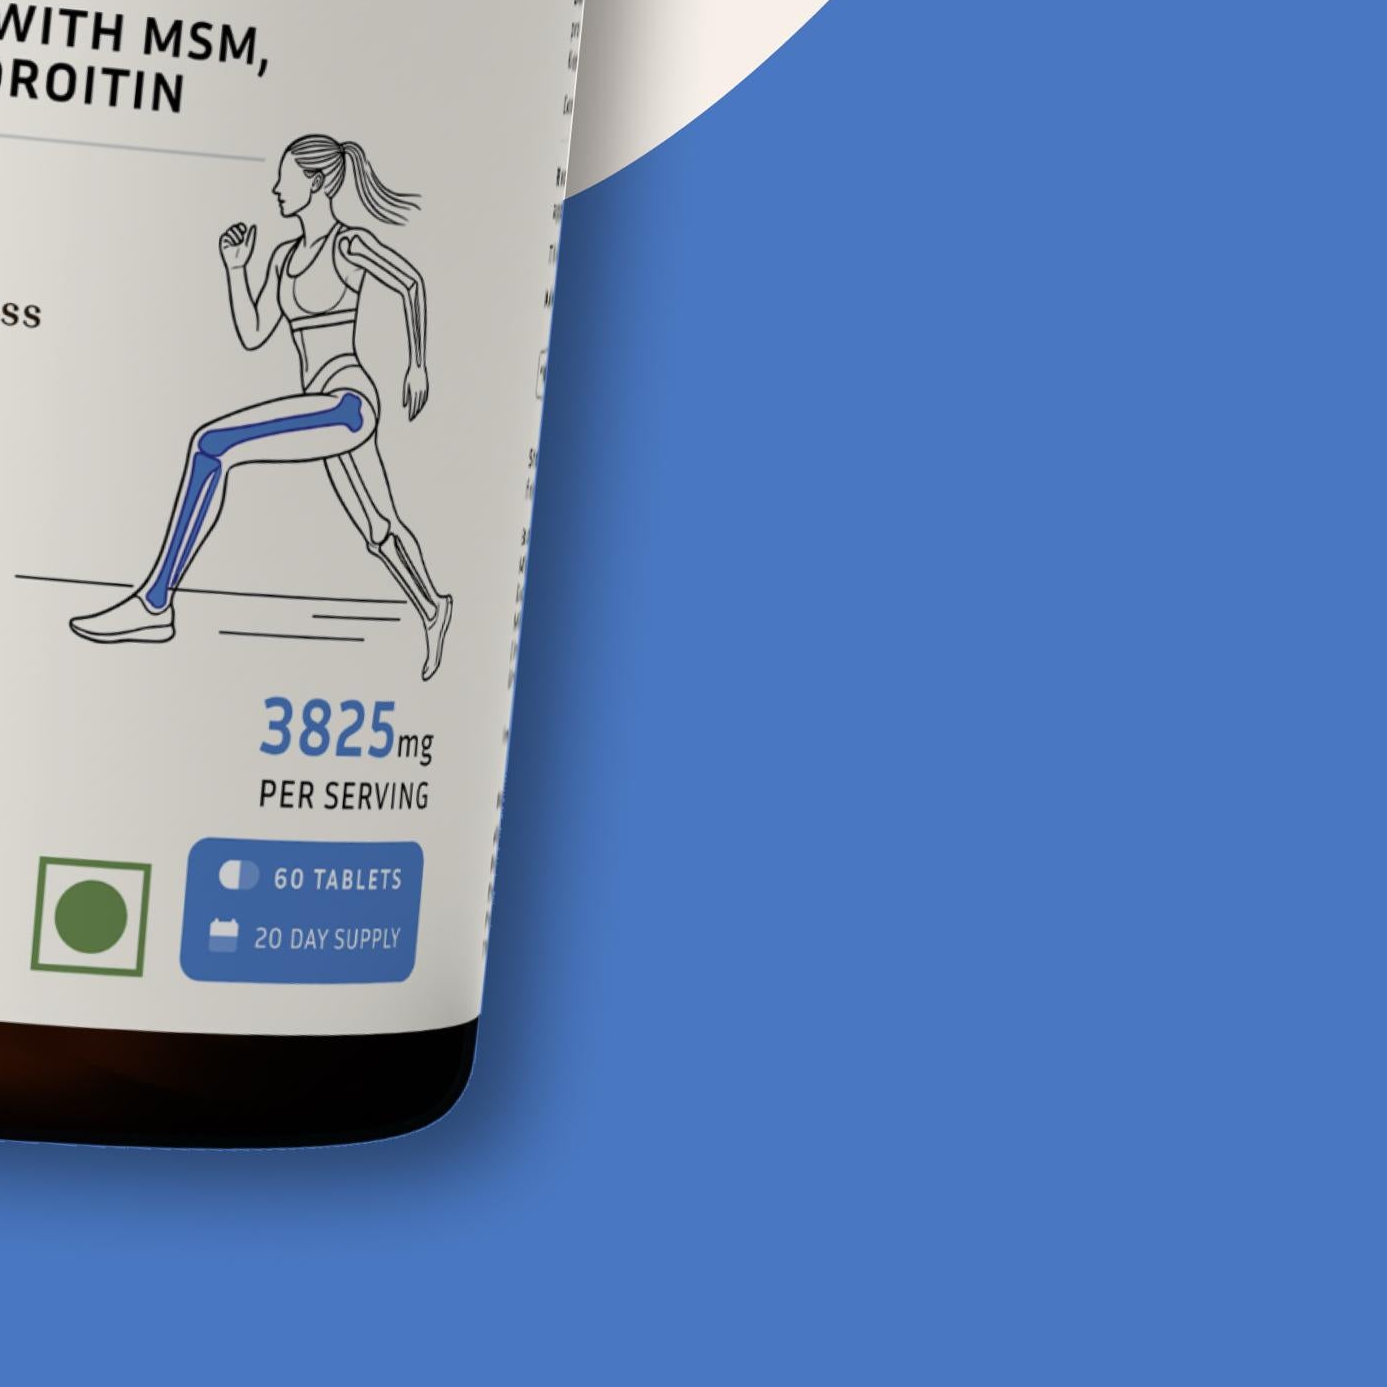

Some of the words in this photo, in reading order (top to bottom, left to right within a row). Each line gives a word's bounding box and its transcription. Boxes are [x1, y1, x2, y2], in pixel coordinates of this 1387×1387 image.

[143, 17, 268, 78] MSM,
[260, 780, 313, 808] PER
[324, 782, 428, 809] SERVING
[275, 868, 303, 889] 60
[314, 869, 401, 889] TABLETS
[256, 927, 281, 948] 20
[291, 929, 328, 948] DAY
[335, 929, 400, 949] SUPPLY
